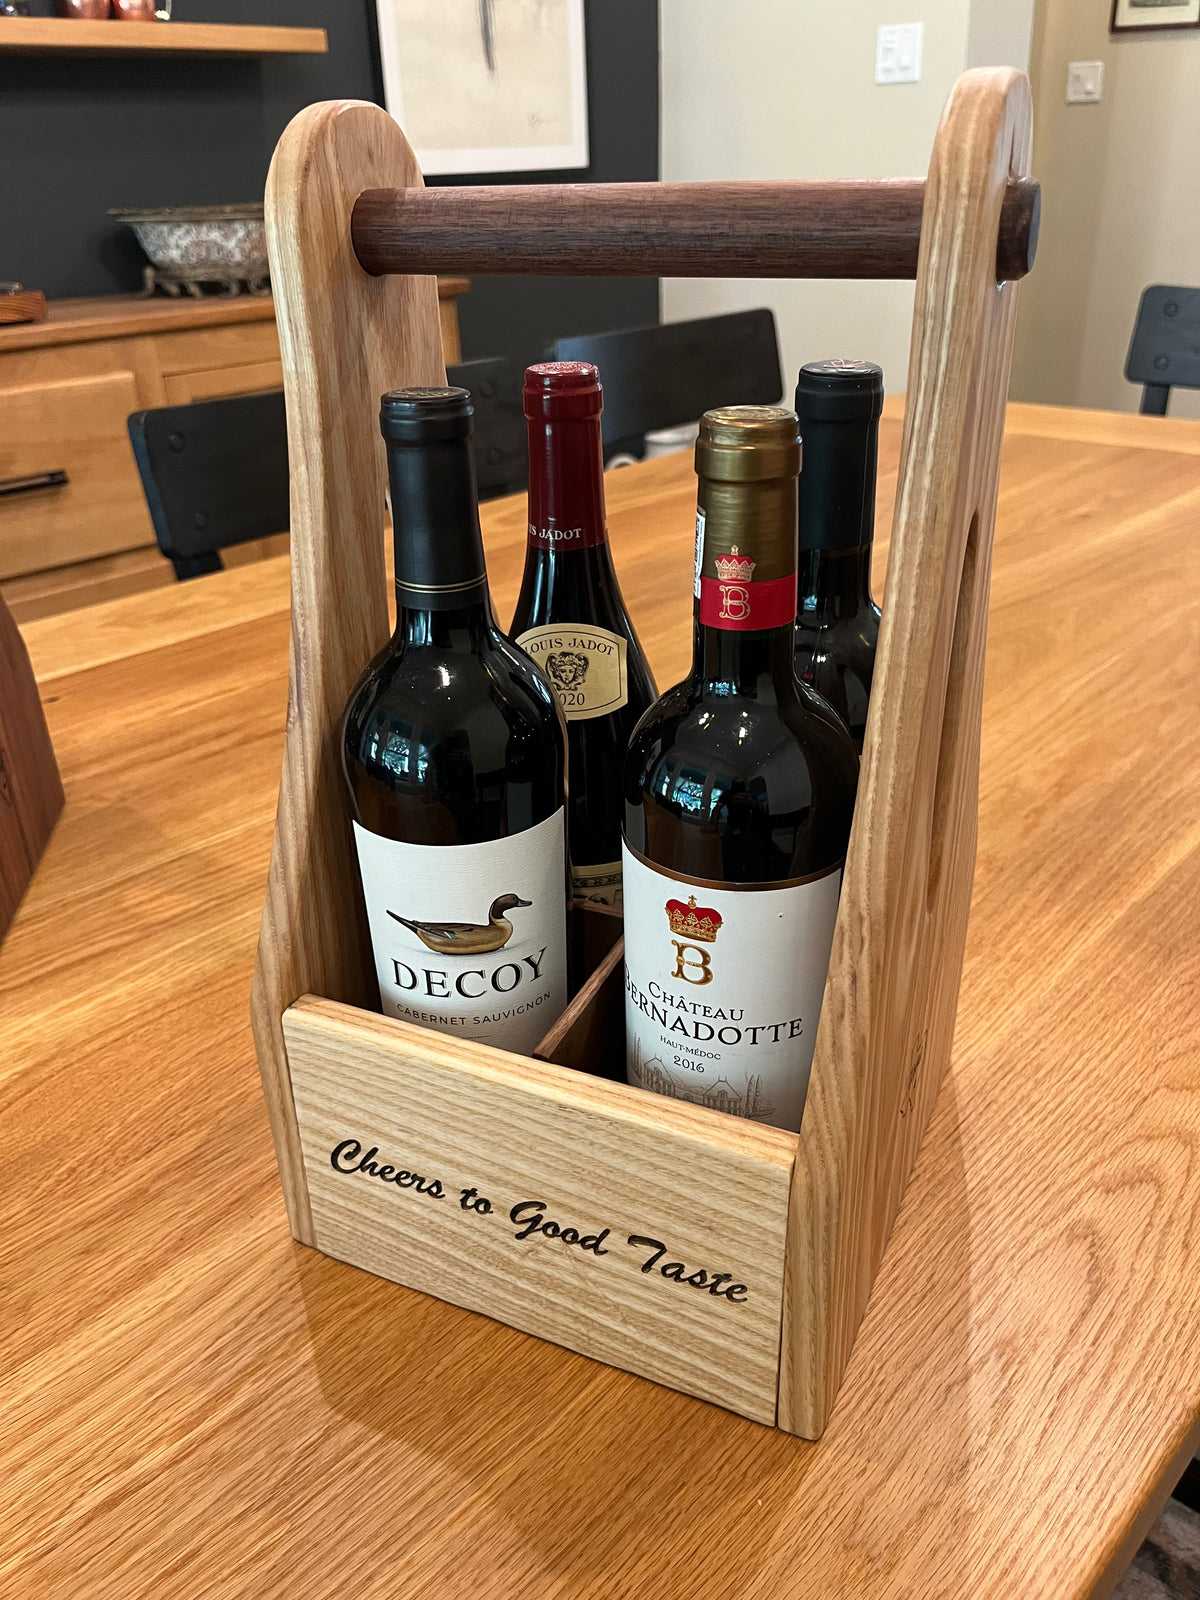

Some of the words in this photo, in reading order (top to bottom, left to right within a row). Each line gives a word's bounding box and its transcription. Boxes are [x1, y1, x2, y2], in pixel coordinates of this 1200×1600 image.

[538, 527, 582, 541] JADOT
[568, 638, 615, 656] JADOT
[559, 692, 585, 706] 020
[390, 945, 548, 999] DECOY
[396, 1003, 466, 1025] CABERNET
[472, 990, 551, 1026] SAUVIGNON
[660, 1034, 722, 1061] HAUT-MÉDOC
[673, 1054, 706, 1073] 2016
[330, 1139, 446, 1200] Cheers
[459, 1187, 495, 1216] to
[509, 1200, 610, 1257] Good
[627, 1234, 749, 1304] Taste
